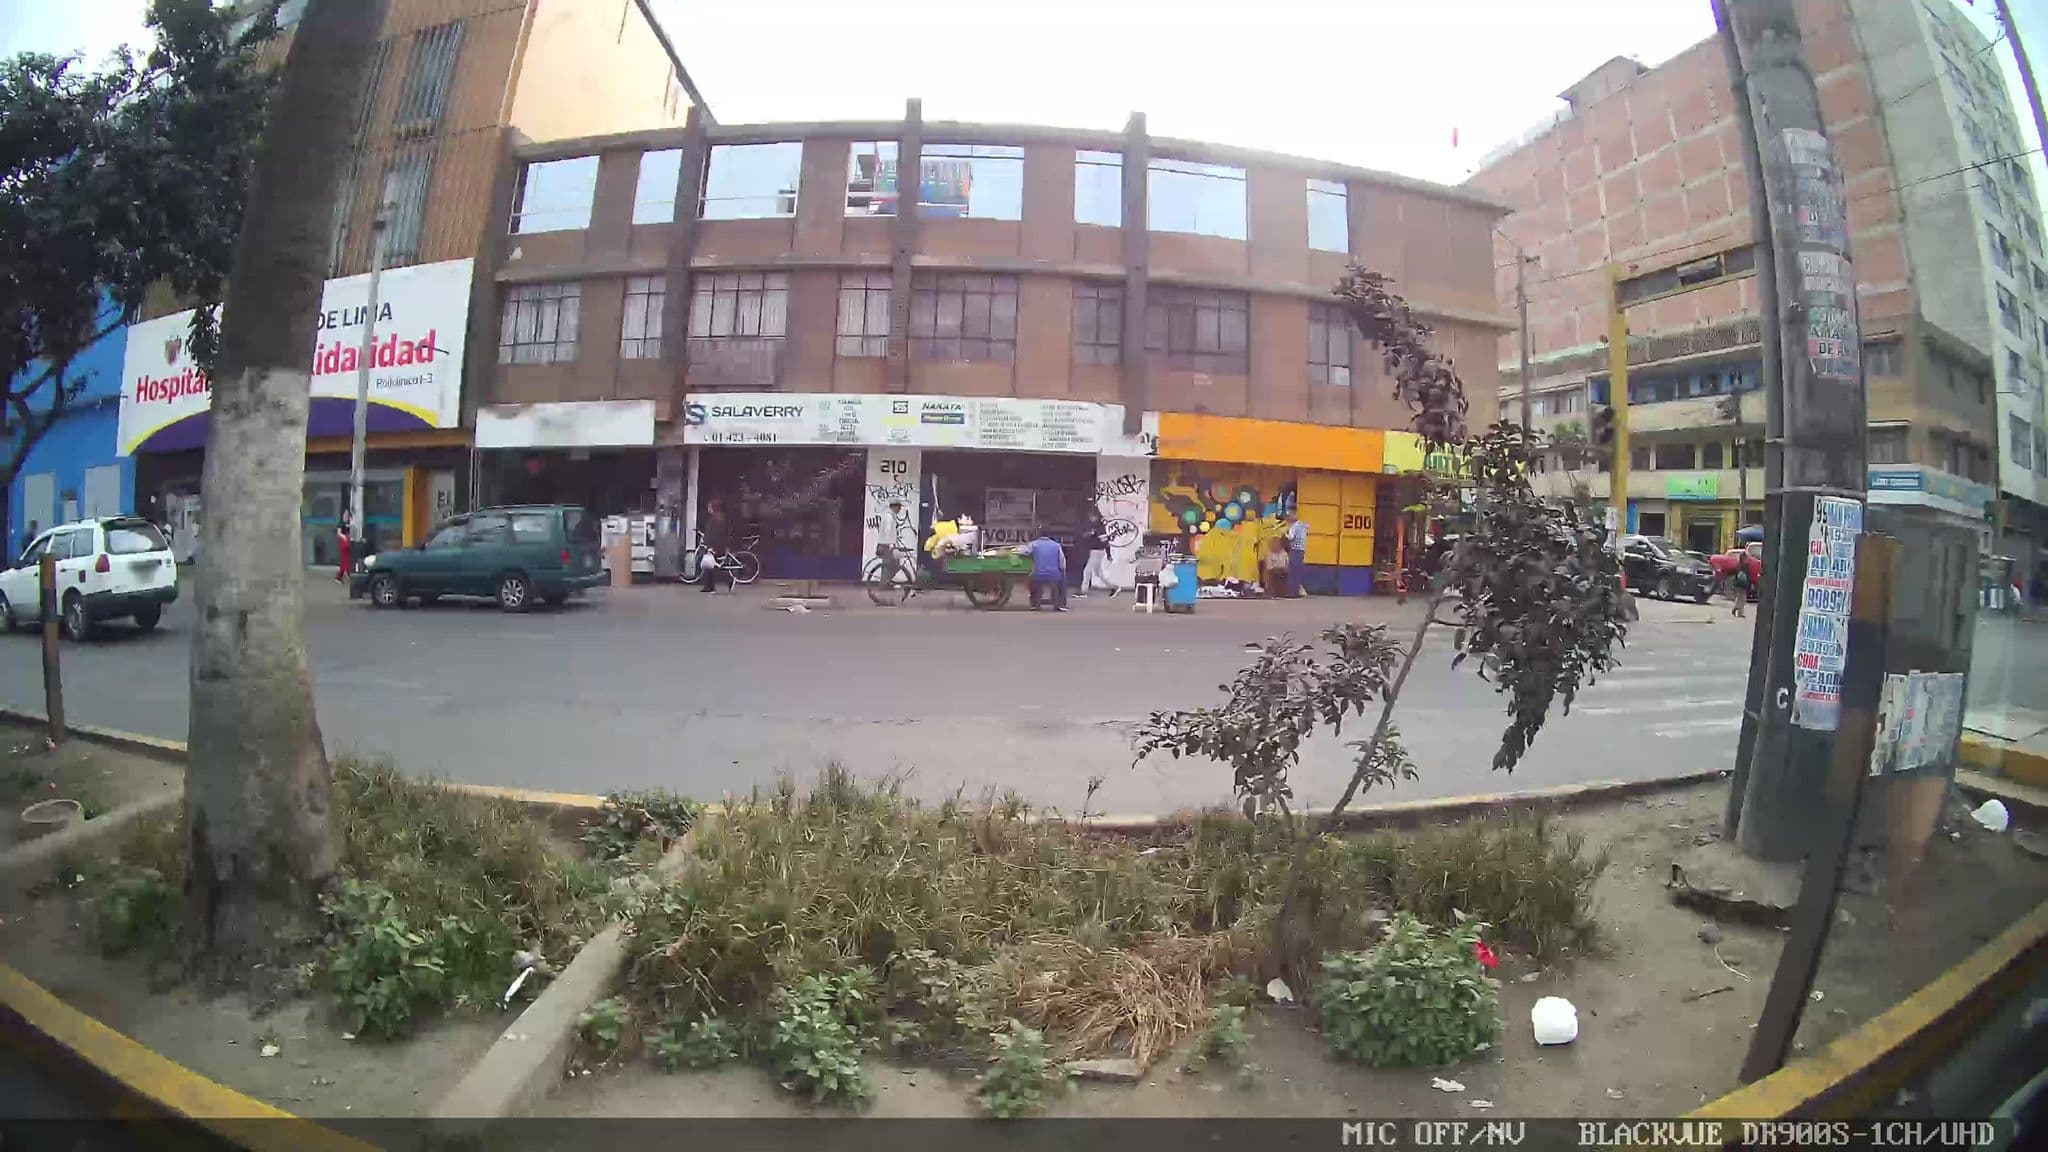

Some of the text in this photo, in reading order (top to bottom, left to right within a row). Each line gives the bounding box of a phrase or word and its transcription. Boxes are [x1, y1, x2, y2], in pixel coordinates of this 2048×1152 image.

[342, 302, 393, 326] LIMA
[136, 368, 207, 404] Hospita
[711, 405, 804, 418] SALAVERRY
[881, 460, 907, 474] 210
[1343, 513, 1372, 530] 200
